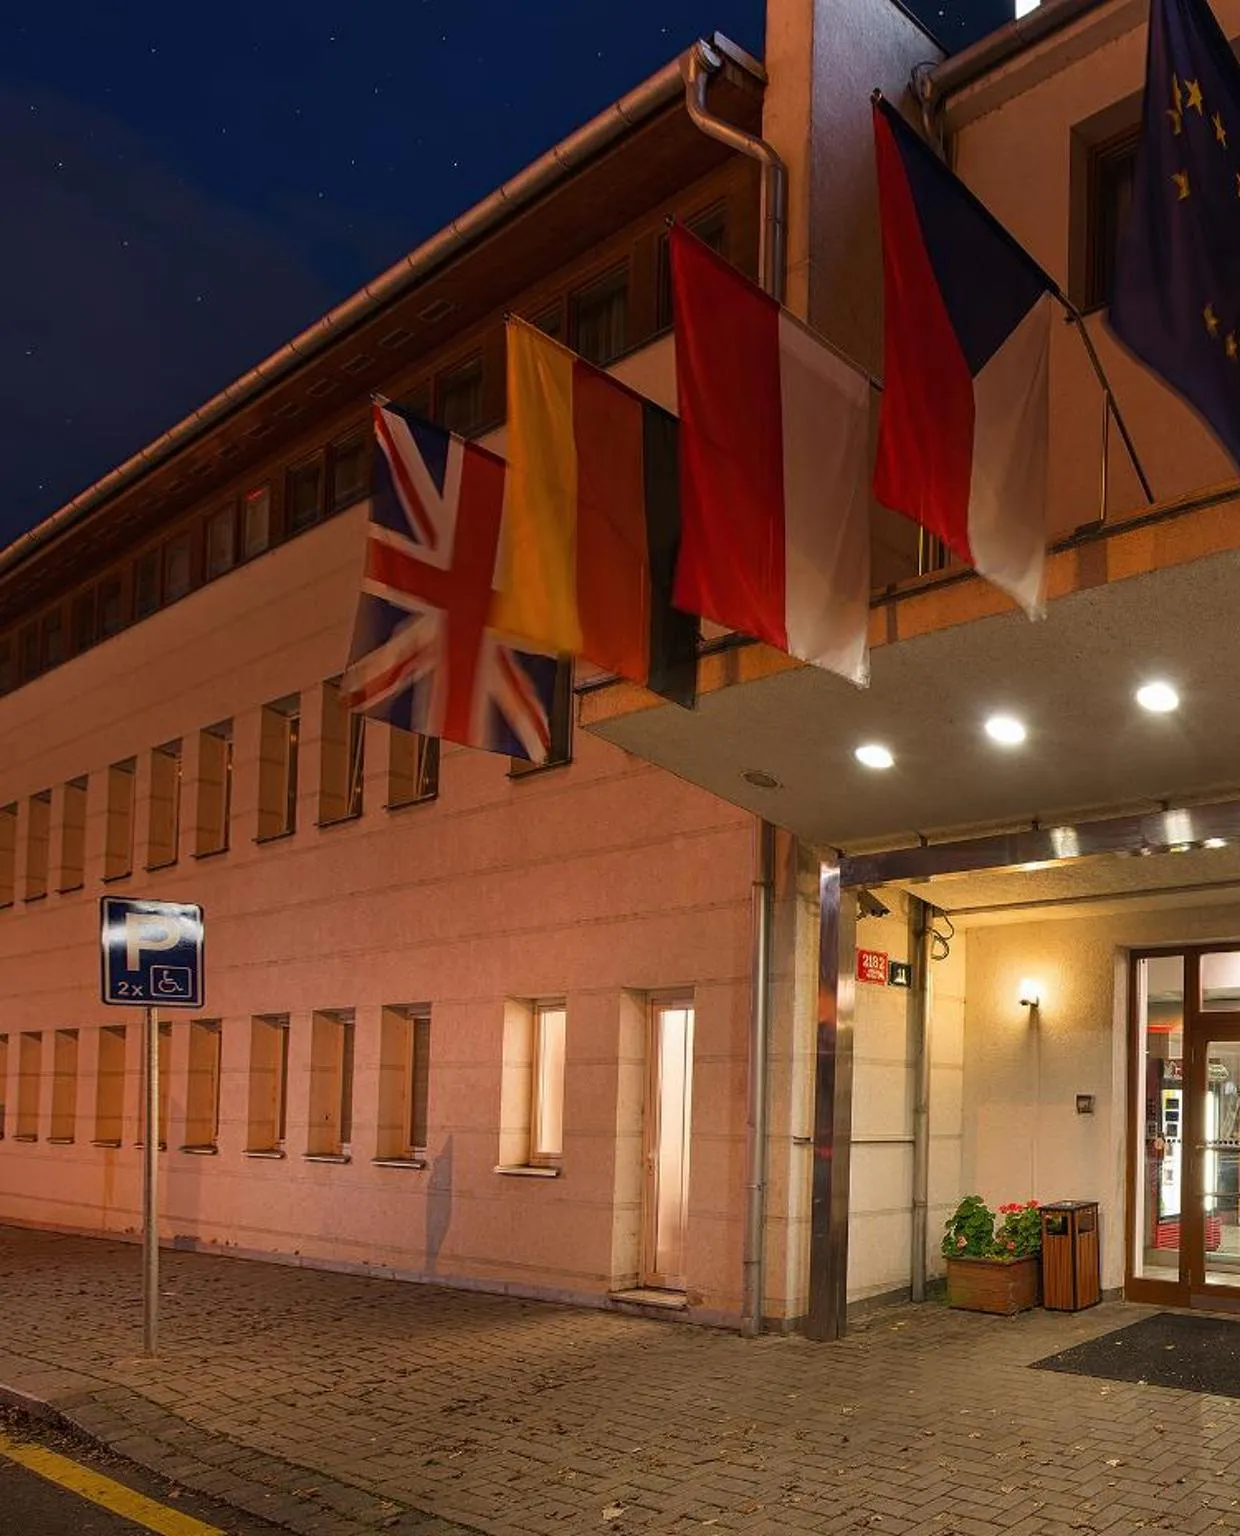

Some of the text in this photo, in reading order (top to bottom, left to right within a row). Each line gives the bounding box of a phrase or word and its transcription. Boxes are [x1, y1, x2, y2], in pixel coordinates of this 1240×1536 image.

[125, 913, 180, 972] P
[862, 953, 885, 969] 2182
[118, 981, 143, 996] 2x
